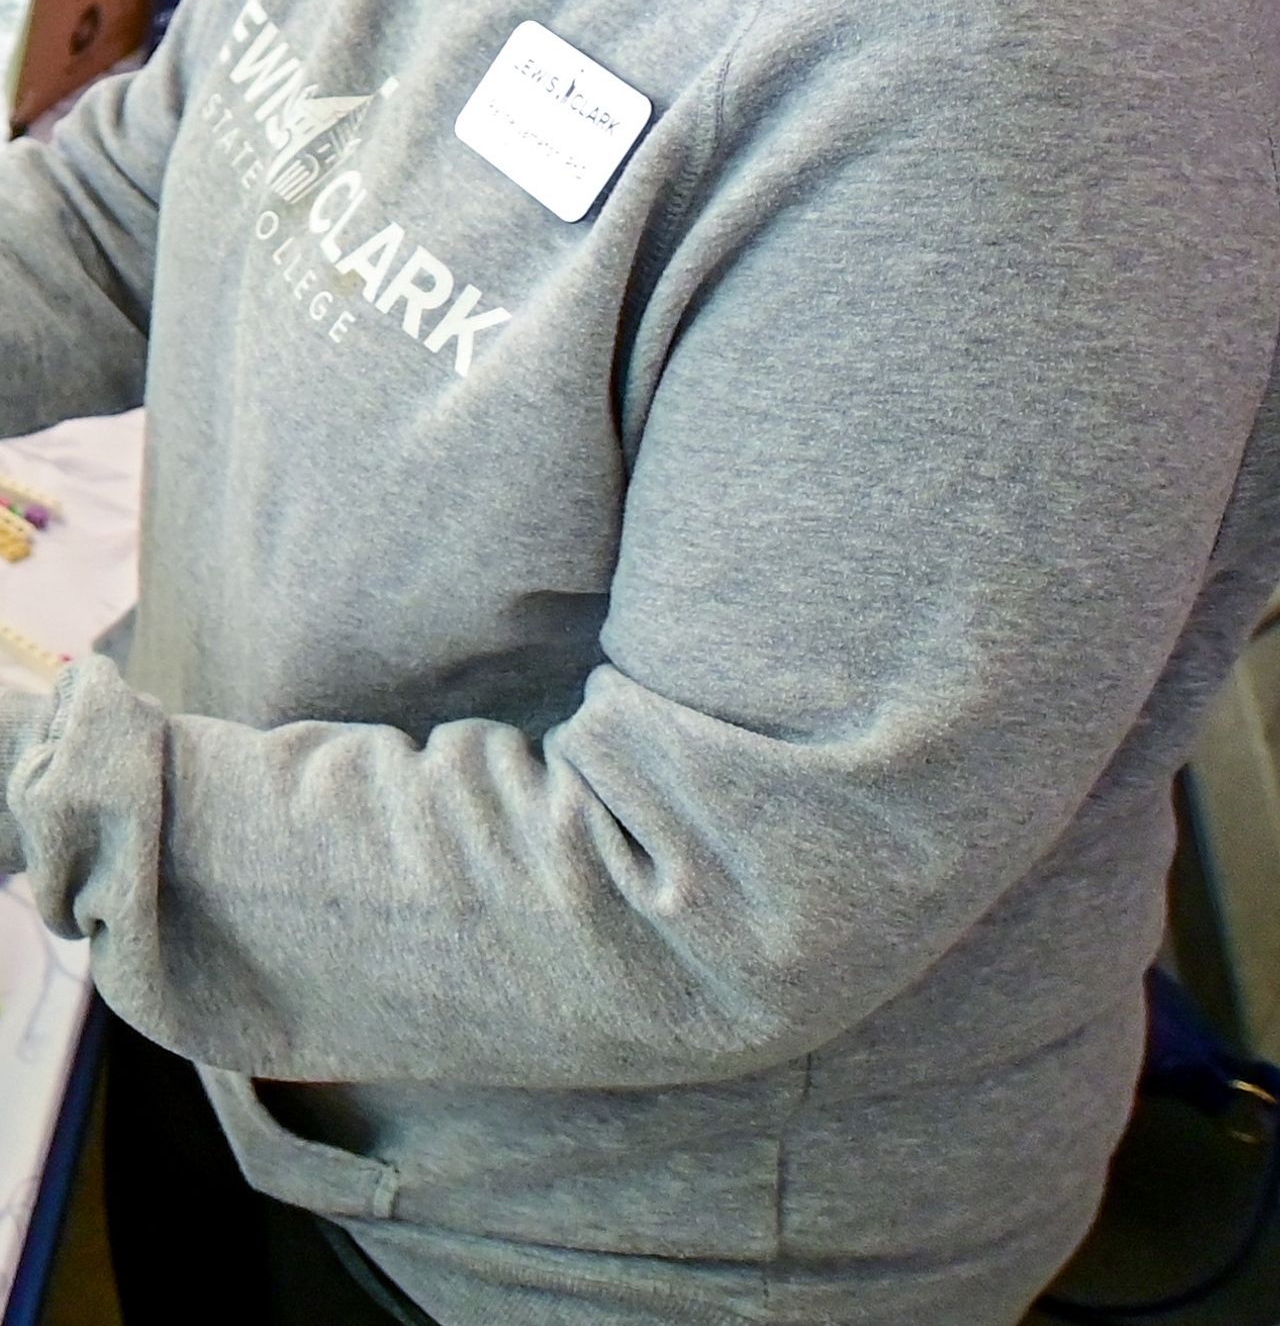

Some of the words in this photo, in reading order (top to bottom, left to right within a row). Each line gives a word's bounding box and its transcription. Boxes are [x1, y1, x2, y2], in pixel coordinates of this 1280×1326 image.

[202, 93, 264, 190] STATE
[255, 210, 356, 344] OLLEGE
[570, 93, 621, 137] CLARK
[309, 170, 512, 377] CLARK
